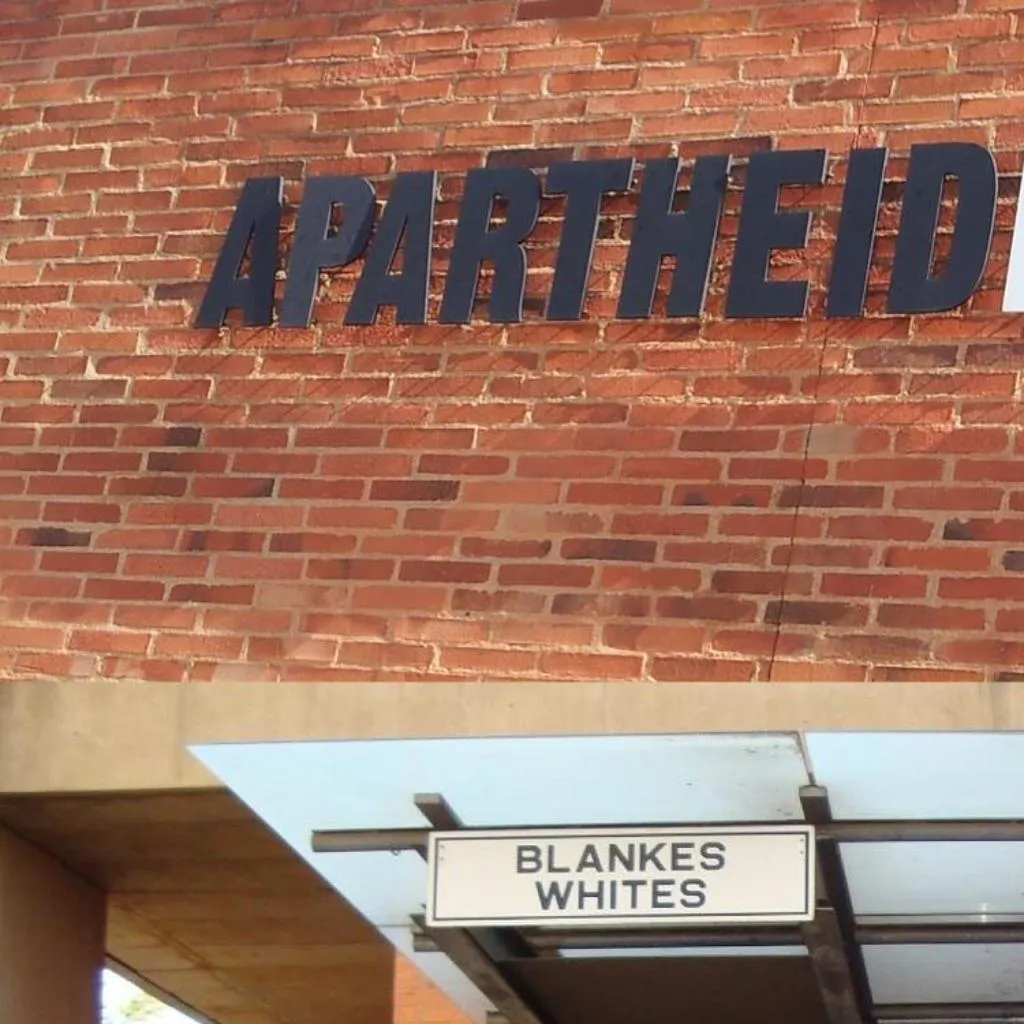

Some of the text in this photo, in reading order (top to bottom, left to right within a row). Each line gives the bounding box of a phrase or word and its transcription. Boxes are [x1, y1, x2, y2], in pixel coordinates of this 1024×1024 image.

[196, 142, 998, 328] APARTHEID
[516, 841, 726, 873] BLANKES
[535, 878, 707, 910] WHITES
